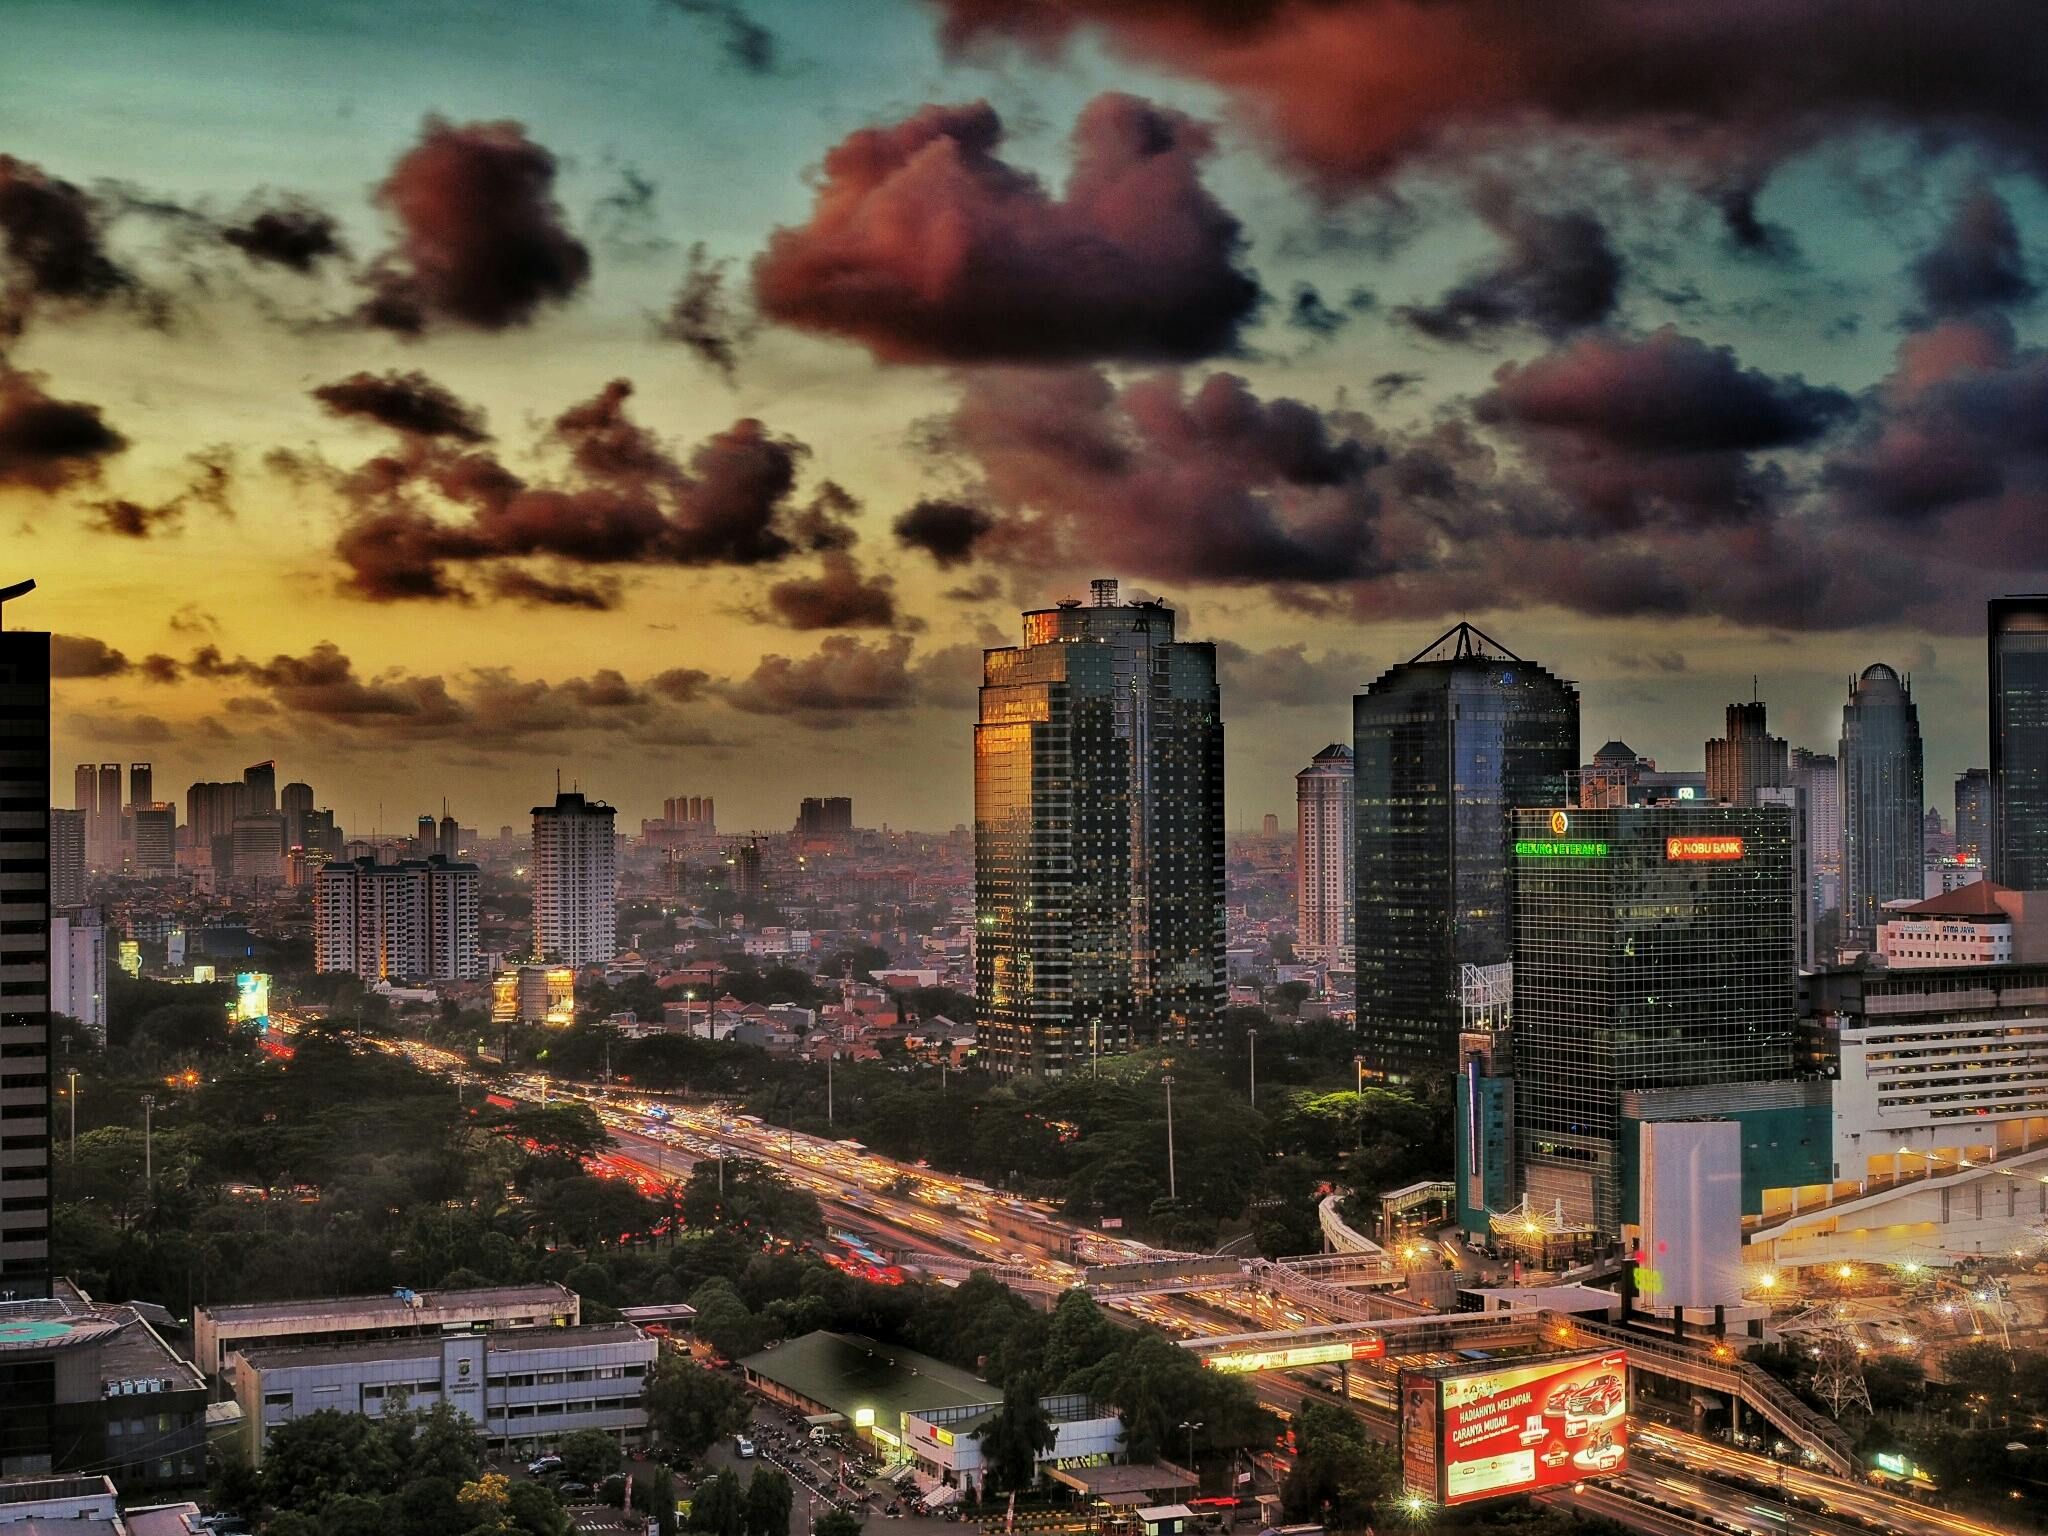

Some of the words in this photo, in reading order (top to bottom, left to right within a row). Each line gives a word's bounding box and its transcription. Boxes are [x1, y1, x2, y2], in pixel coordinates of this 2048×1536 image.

[1515, 843, 1552, 854] GEDUNG
[1553, 844, 1595, 855] VETERAN
[1684, 843, 1711, 854] NOBU
[1713, 843, 1740, 853] BANK
[1943, 925, 1958, 933] ATMA
[1960, 926, 1975, 934] JAYA
[1265, 1353, 1282, 1362] TWIN
[1459, 1403, 1496, 1424] HADIAHNYA
[1497, 1392, 1533, 1412] MELIMPAH.
[1452, 1423, 1483, 1443] CARANYA
[1483, 1415, 1508, 1432] MUDAH
